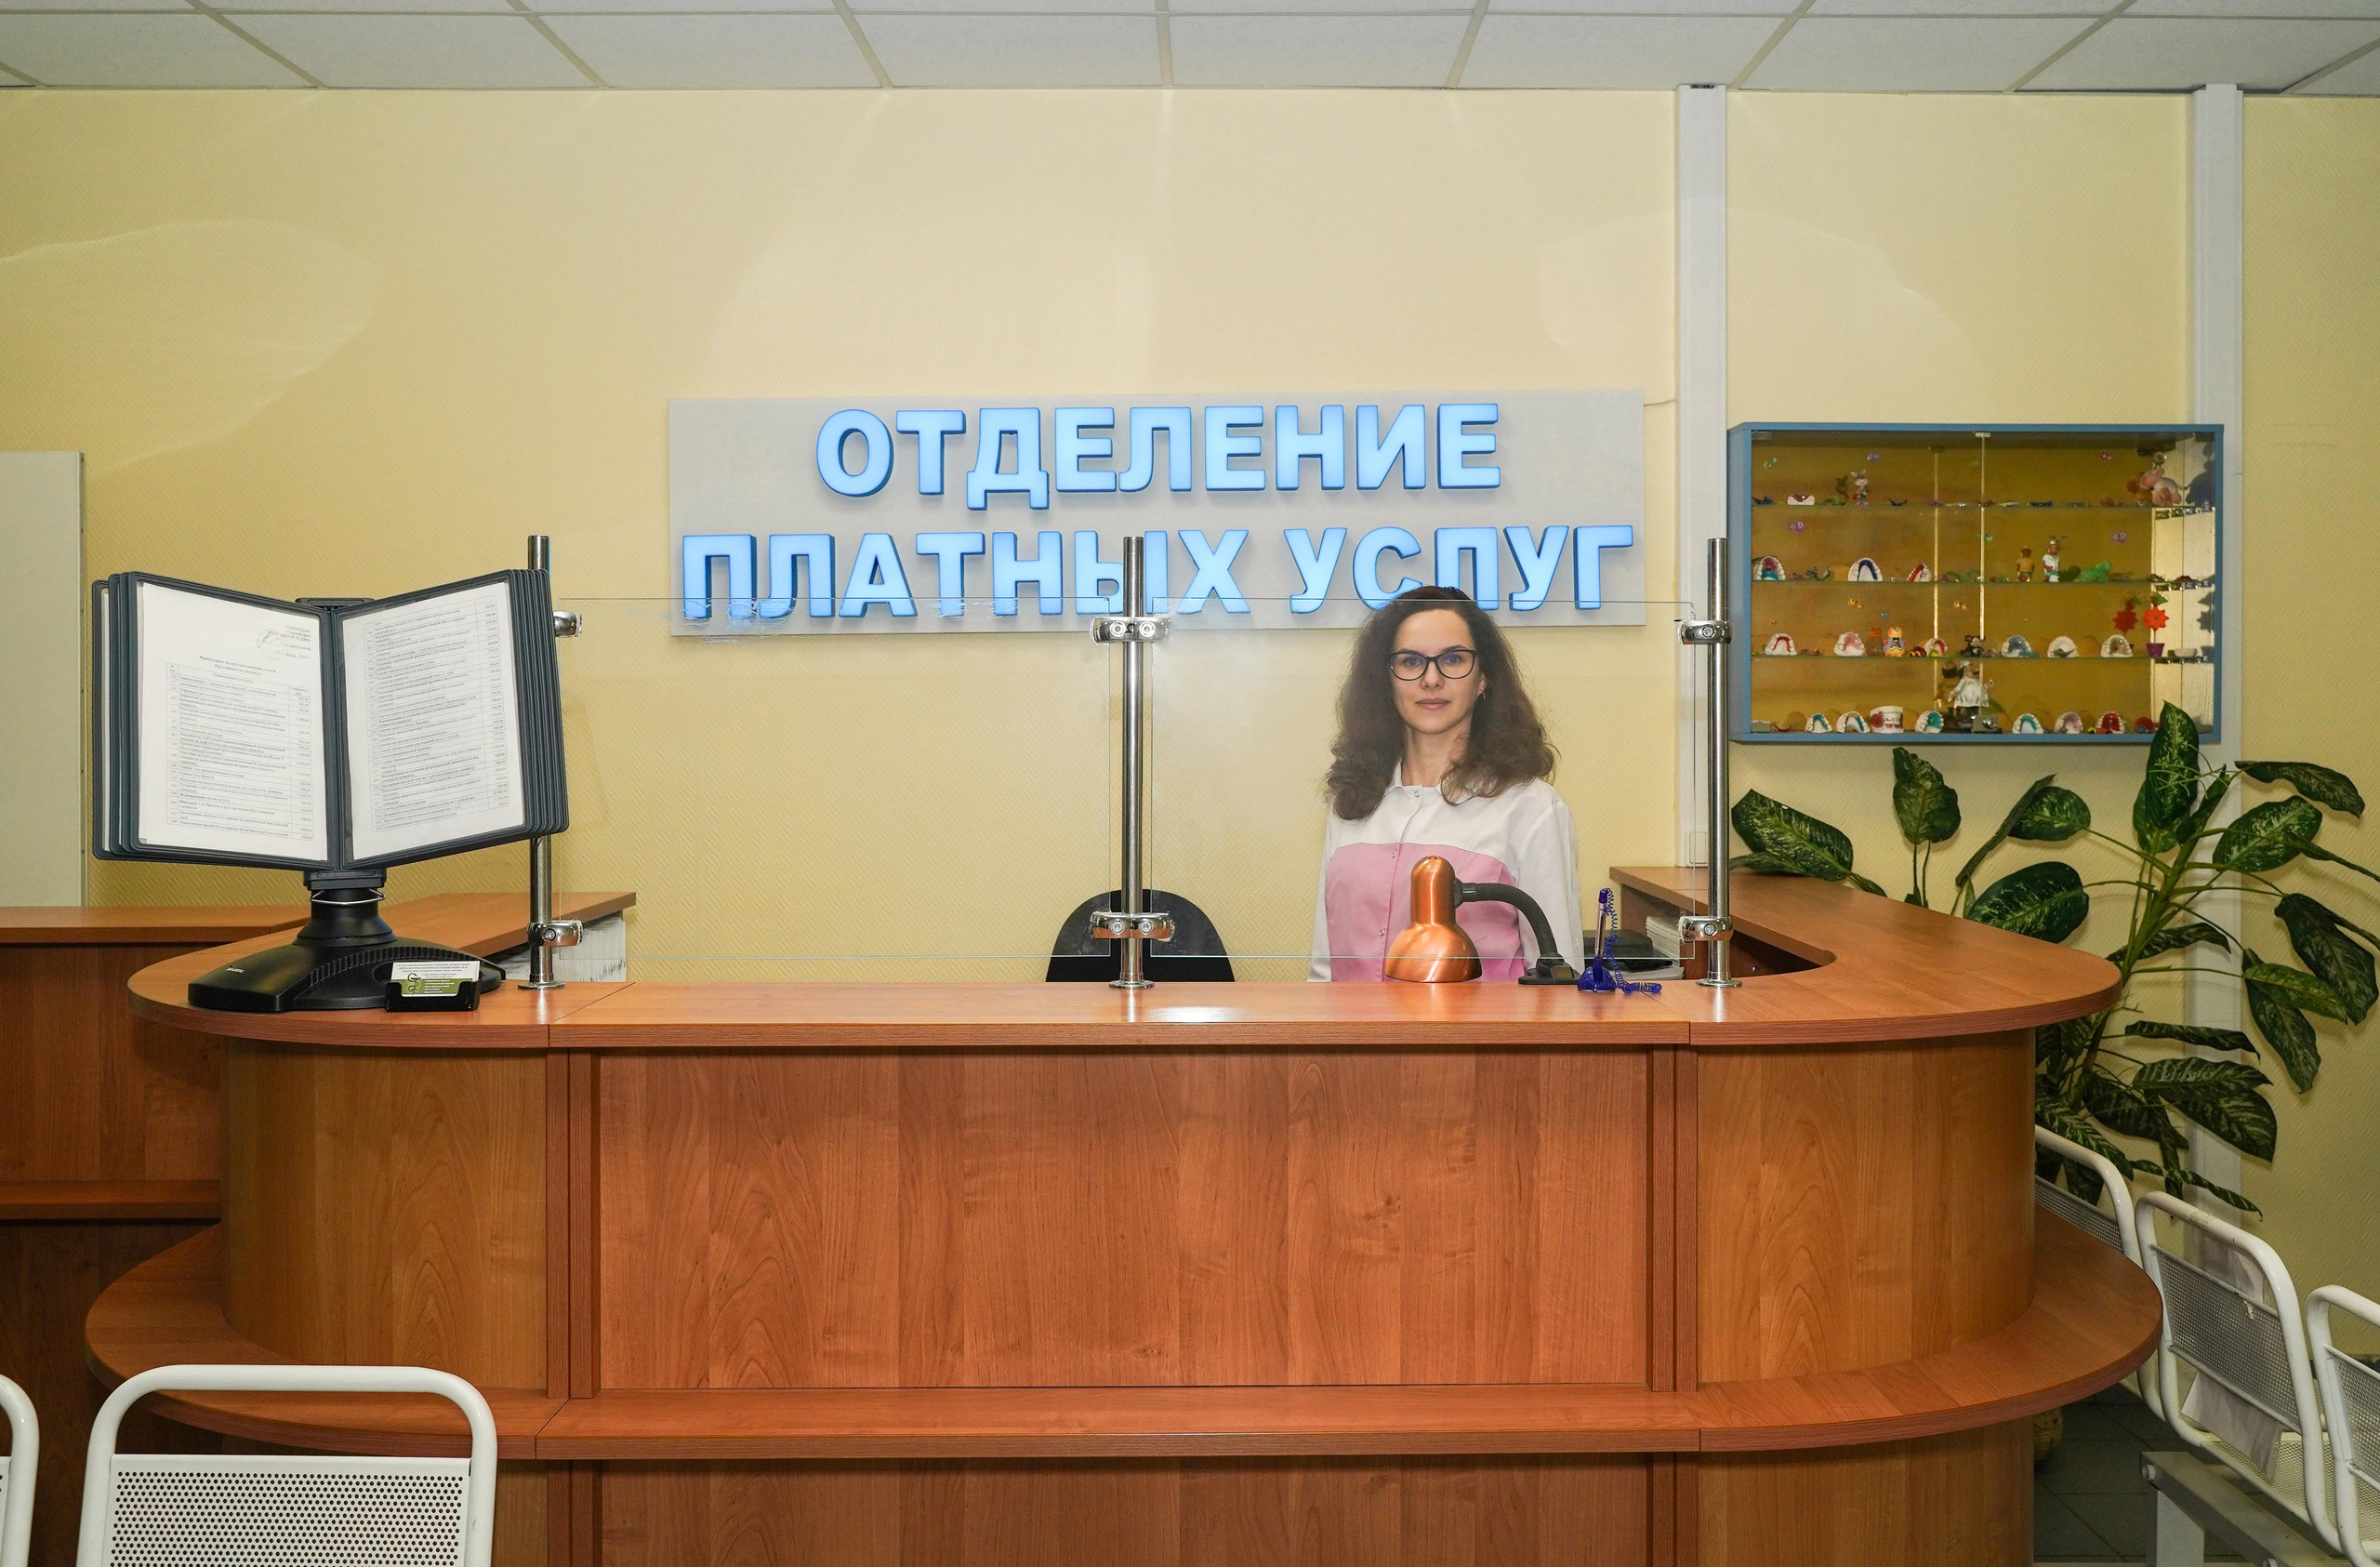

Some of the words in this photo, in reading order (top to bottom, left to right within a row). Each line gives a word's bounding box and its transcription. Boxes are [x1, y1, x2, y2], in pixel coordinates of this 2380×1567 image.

[815, 403, 1502, 511] ОТДЕЛЕНИЕ
[682, 529, 1251, 618] ПЛАТНЫХ
[1282, 525, 1634, 615] УСЛУГ
